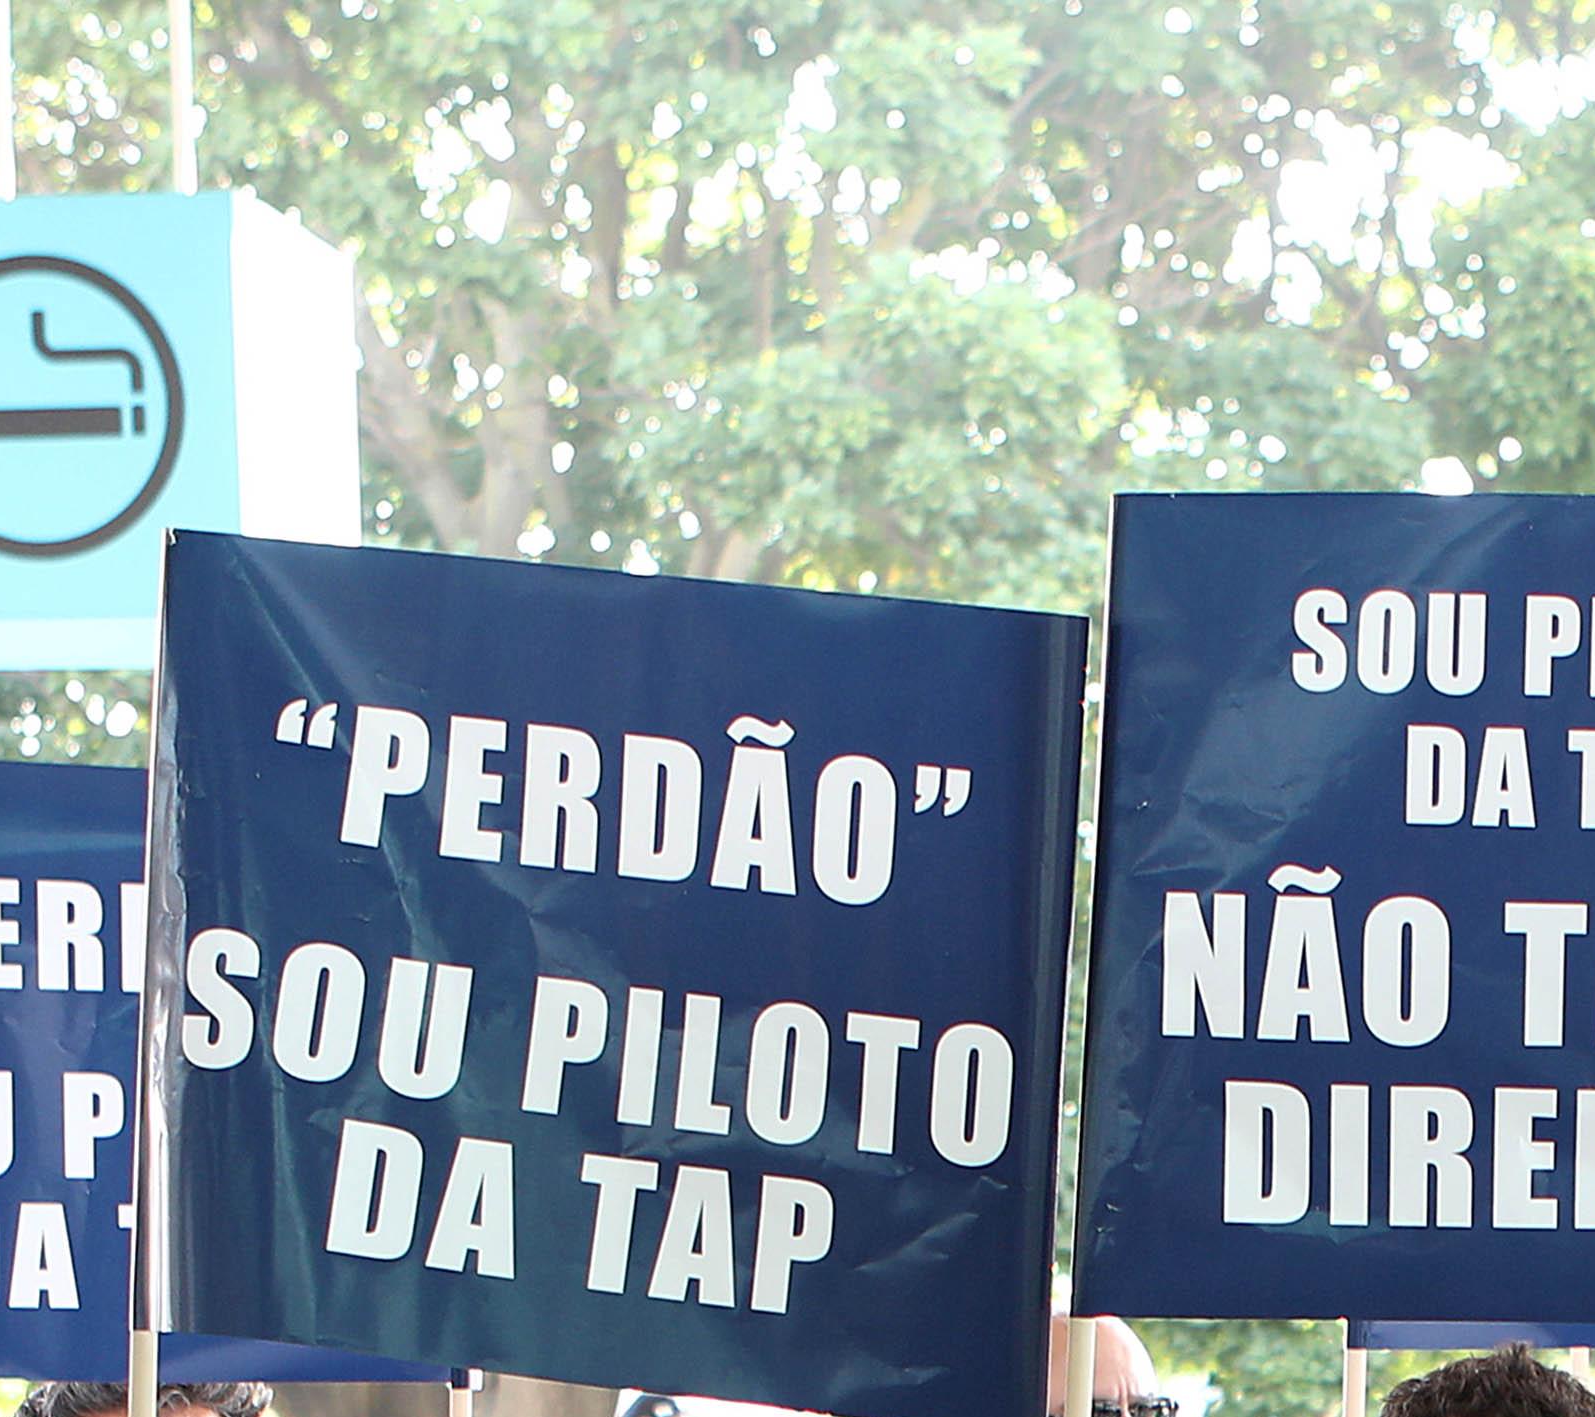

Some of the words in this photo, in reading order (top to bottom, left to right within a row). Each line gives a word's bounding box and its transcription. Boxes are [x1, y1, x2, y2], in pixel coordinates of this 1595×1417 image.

[1291, 589, 1487, 696] SOU
[275, 698, 972, 905] “PERDÃO”
[1405, 724, 1537, 829] DA
[180, 928, 474, 1100] SOU
[520, 975, 1014, 1168] PILOTO
[1161, 864, 1451, 1047] NÃO
[325, 1118, 515, 1280] DA
[580, 1152, 834, 1315] TAP
